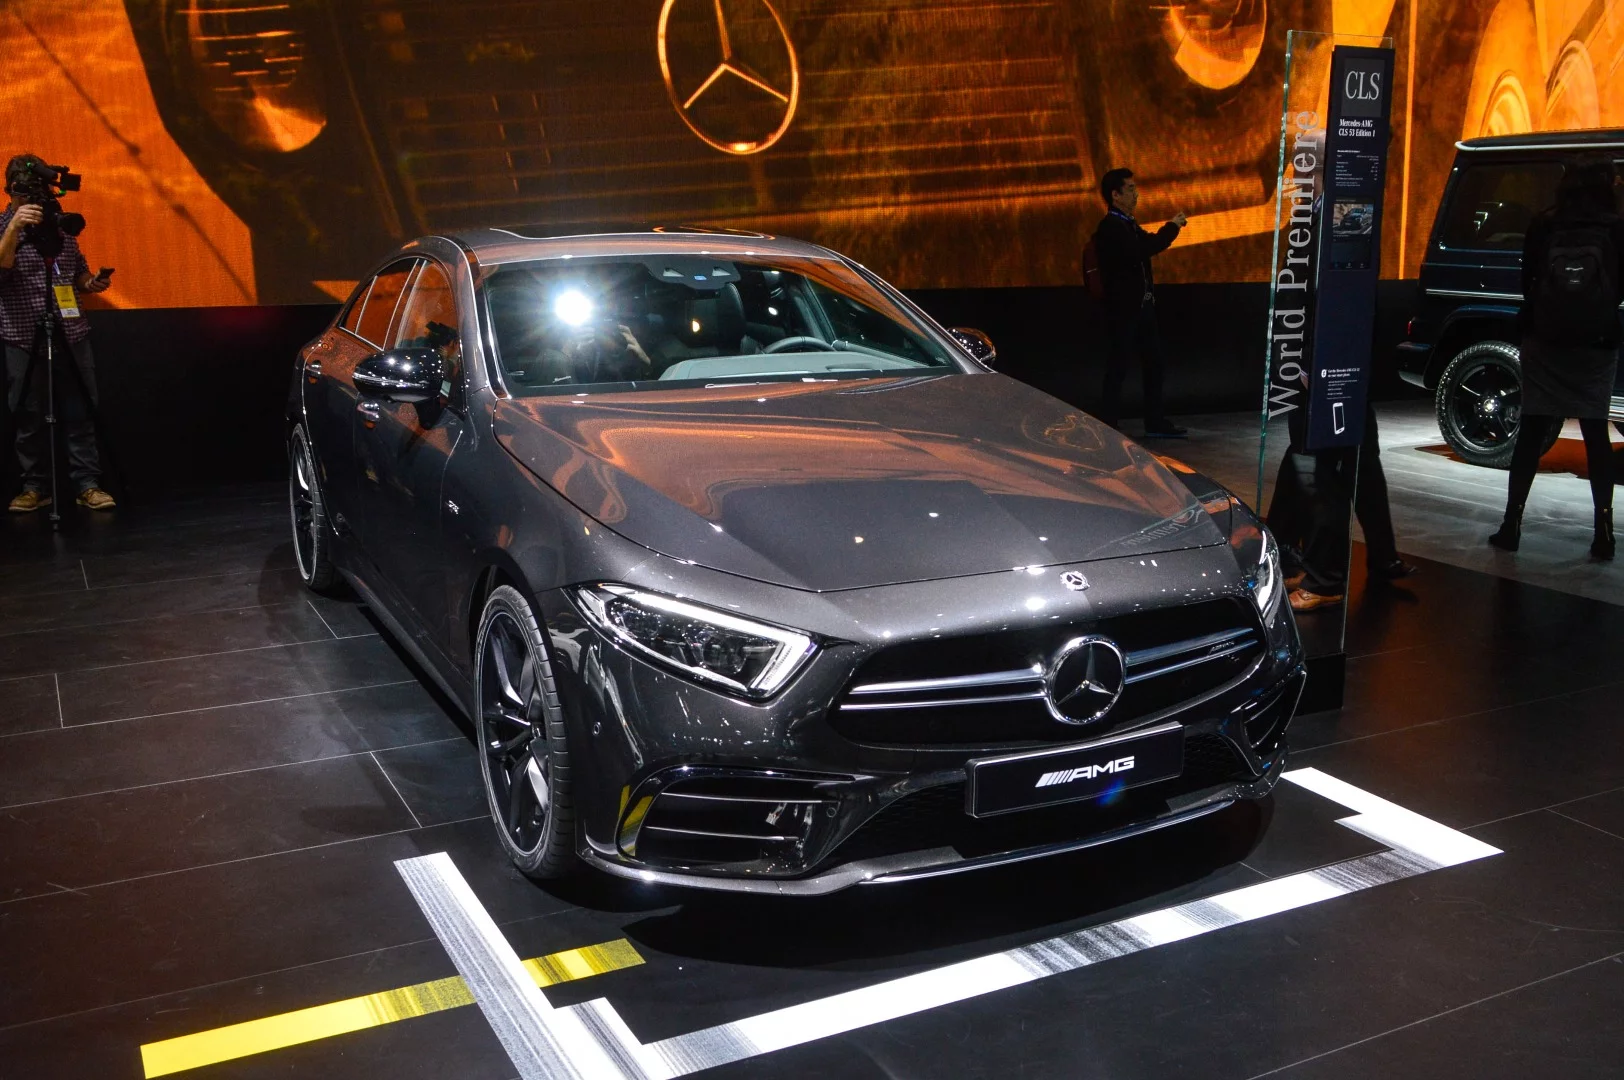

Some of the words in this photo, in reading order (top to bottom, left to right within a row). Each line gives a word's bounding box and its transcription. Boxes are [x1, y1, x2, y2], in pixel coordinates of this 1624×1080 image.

[1345, 70, 1380, 101] CLS
[1339, 128, 1348, 136] CLS
[1277, 111, 1319, 292] Premiere
[1268, 306, 1306, 420] World
[1067, 755, 1135, 782] AMG
